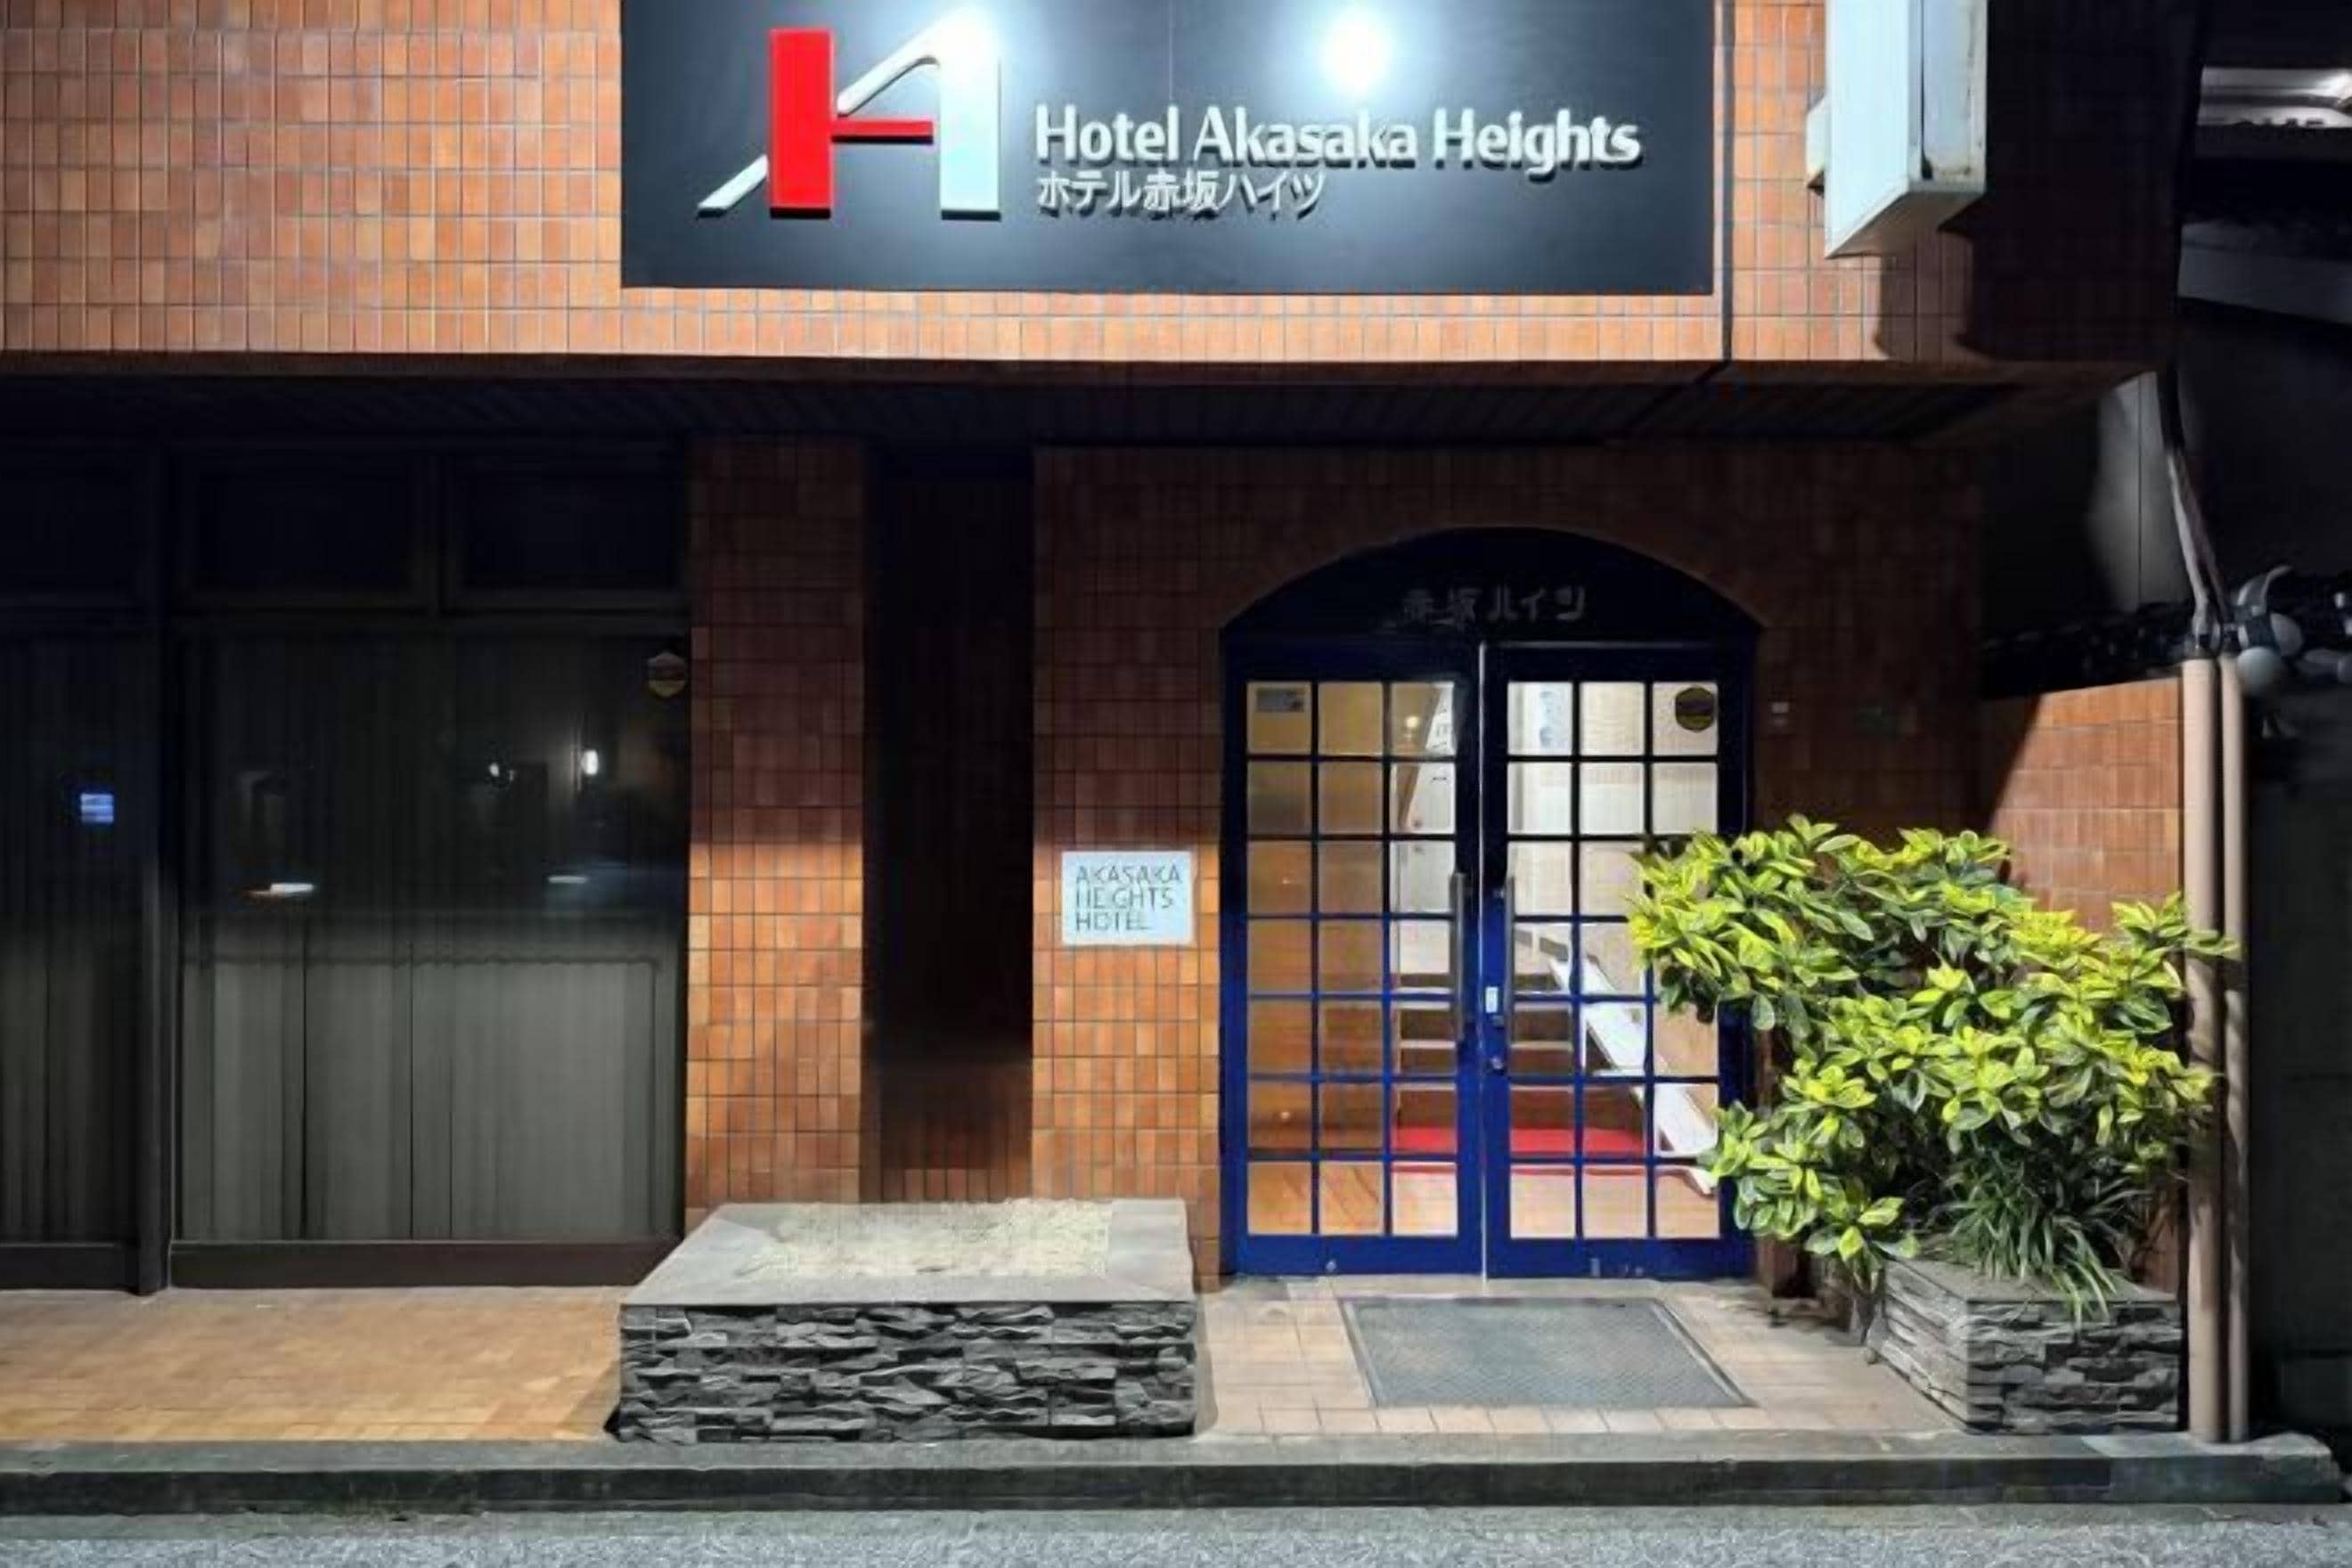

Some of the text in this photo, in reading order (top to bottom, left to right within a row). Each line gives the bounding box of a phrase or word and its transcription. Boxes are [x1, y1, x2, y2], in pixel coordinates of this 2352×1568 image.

[1035, 104, 1644, 181] Hotel Akasaka Heights
[1036, 167, 1325, 215] ホテル赤坂ハイツ
[1076, 864, 1183, 884] AKASAKA
[1076, 886, 1174, 911] HEGHTS
[1076, 912, 1152, 932] HOTEL
